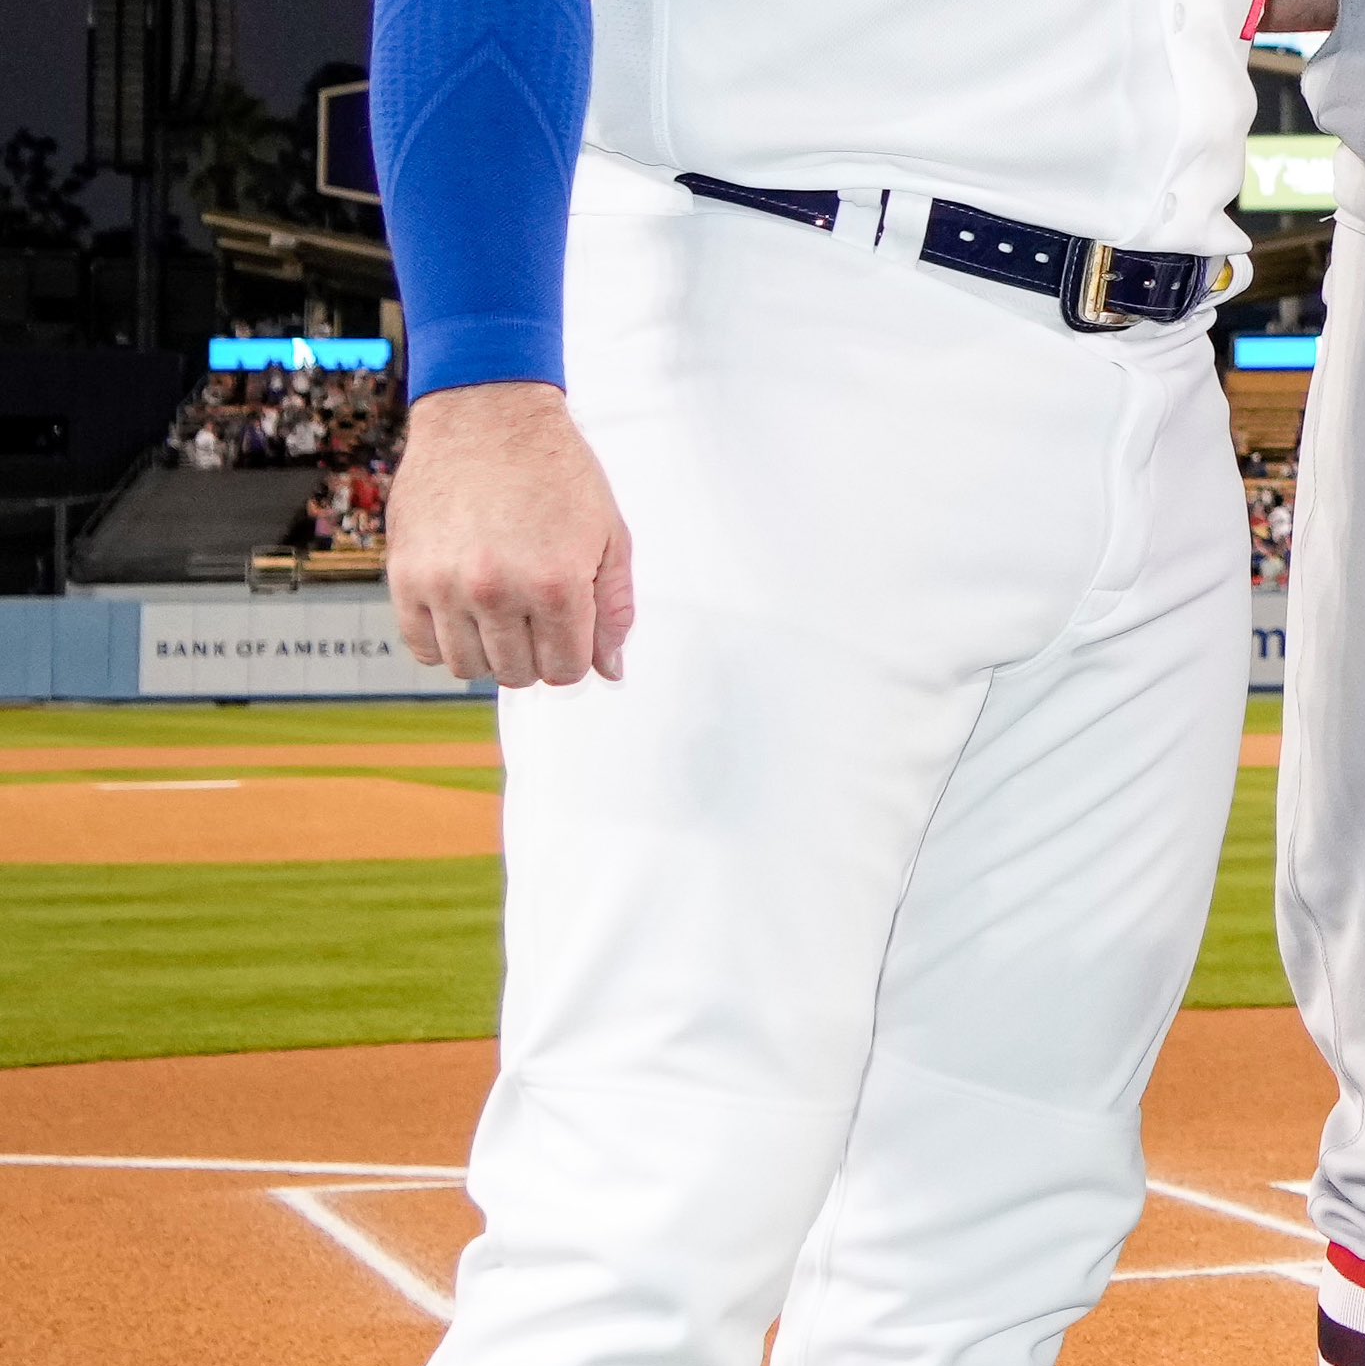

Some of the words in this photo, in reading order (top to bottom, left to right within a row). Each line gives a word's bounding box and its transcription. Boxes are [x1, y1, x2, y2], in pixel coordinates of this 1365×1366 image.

[156, 639, 226, 659] BANK
[236, 639, 268, 659] OF
[276, 638, 392, 659] AMERICA
